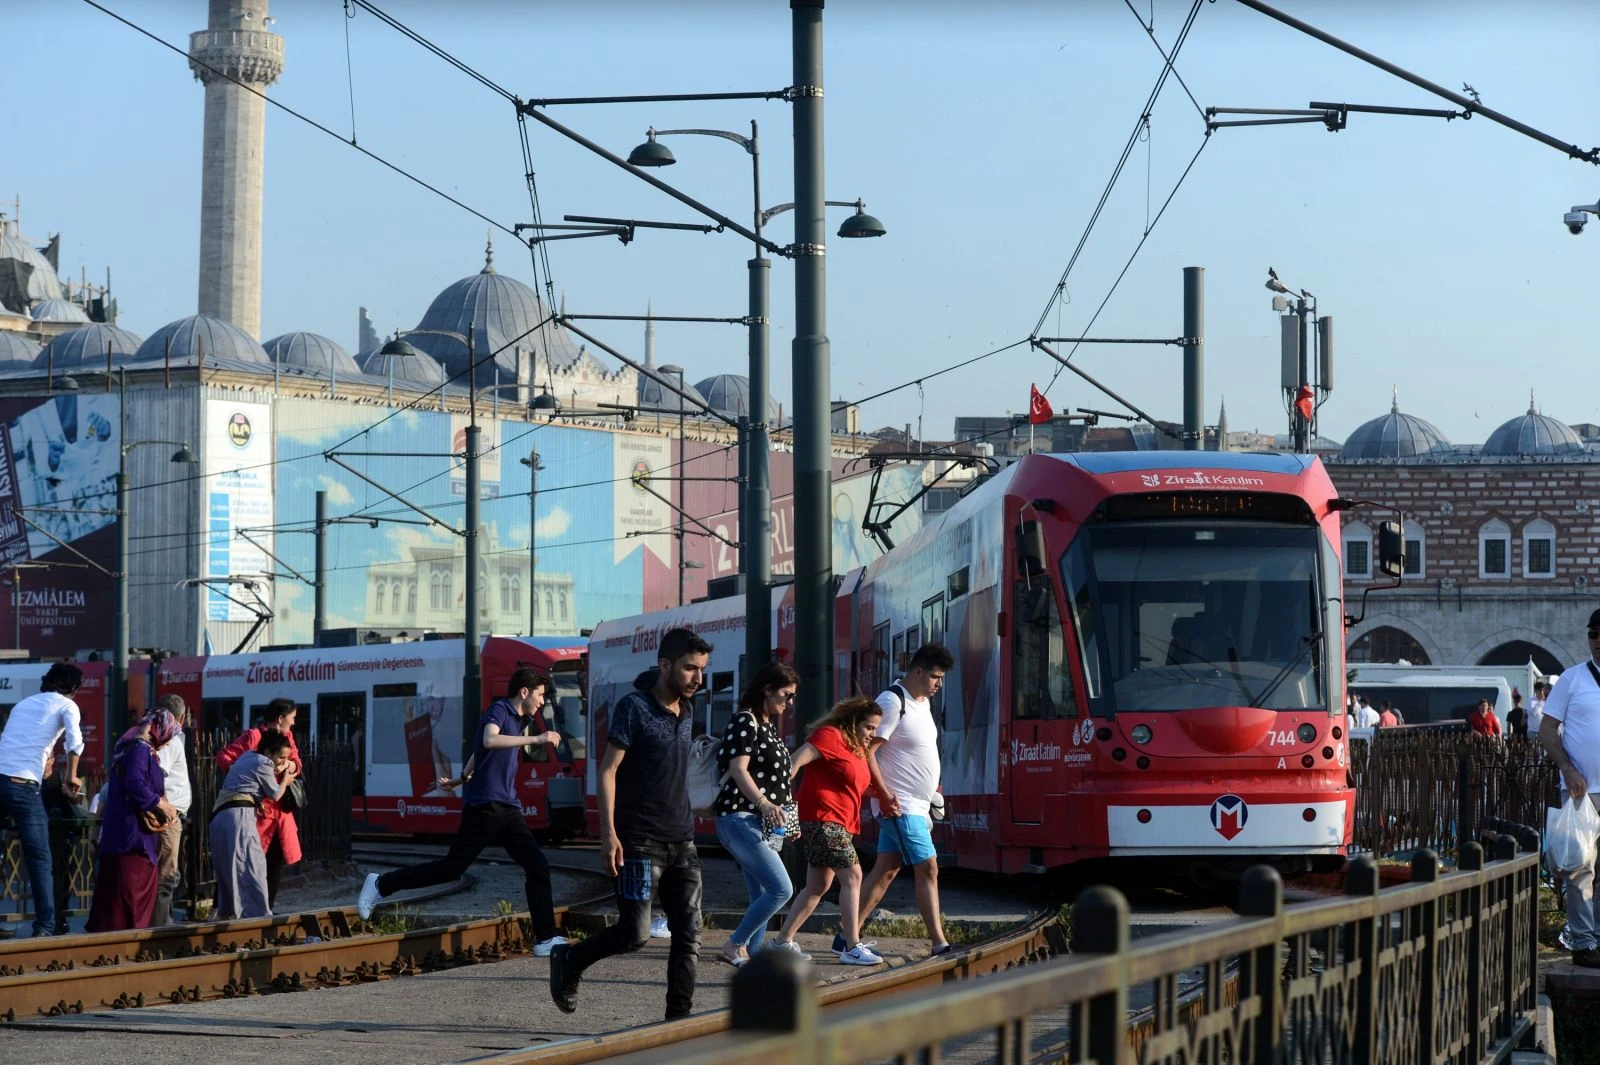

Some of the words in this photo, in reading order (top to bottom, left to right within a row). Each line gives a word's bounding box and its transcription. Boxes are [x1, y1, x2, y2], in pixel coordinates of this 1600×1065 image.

[1163, 475, 1210, 486] Ziraat
[1212, 475, 1264, 486] Katılım
[715, 524, 732, 572] 2
[632, 622, 658, 654] Ziraat
[246, 661, 284, 684] Ziraat
[288, 657, 336, 682] Katılım
[1267, 731, 1296, 746] 744
[1019, 742, 1040, 761] Ziraat
[1277, 756, 1287, 769] A
